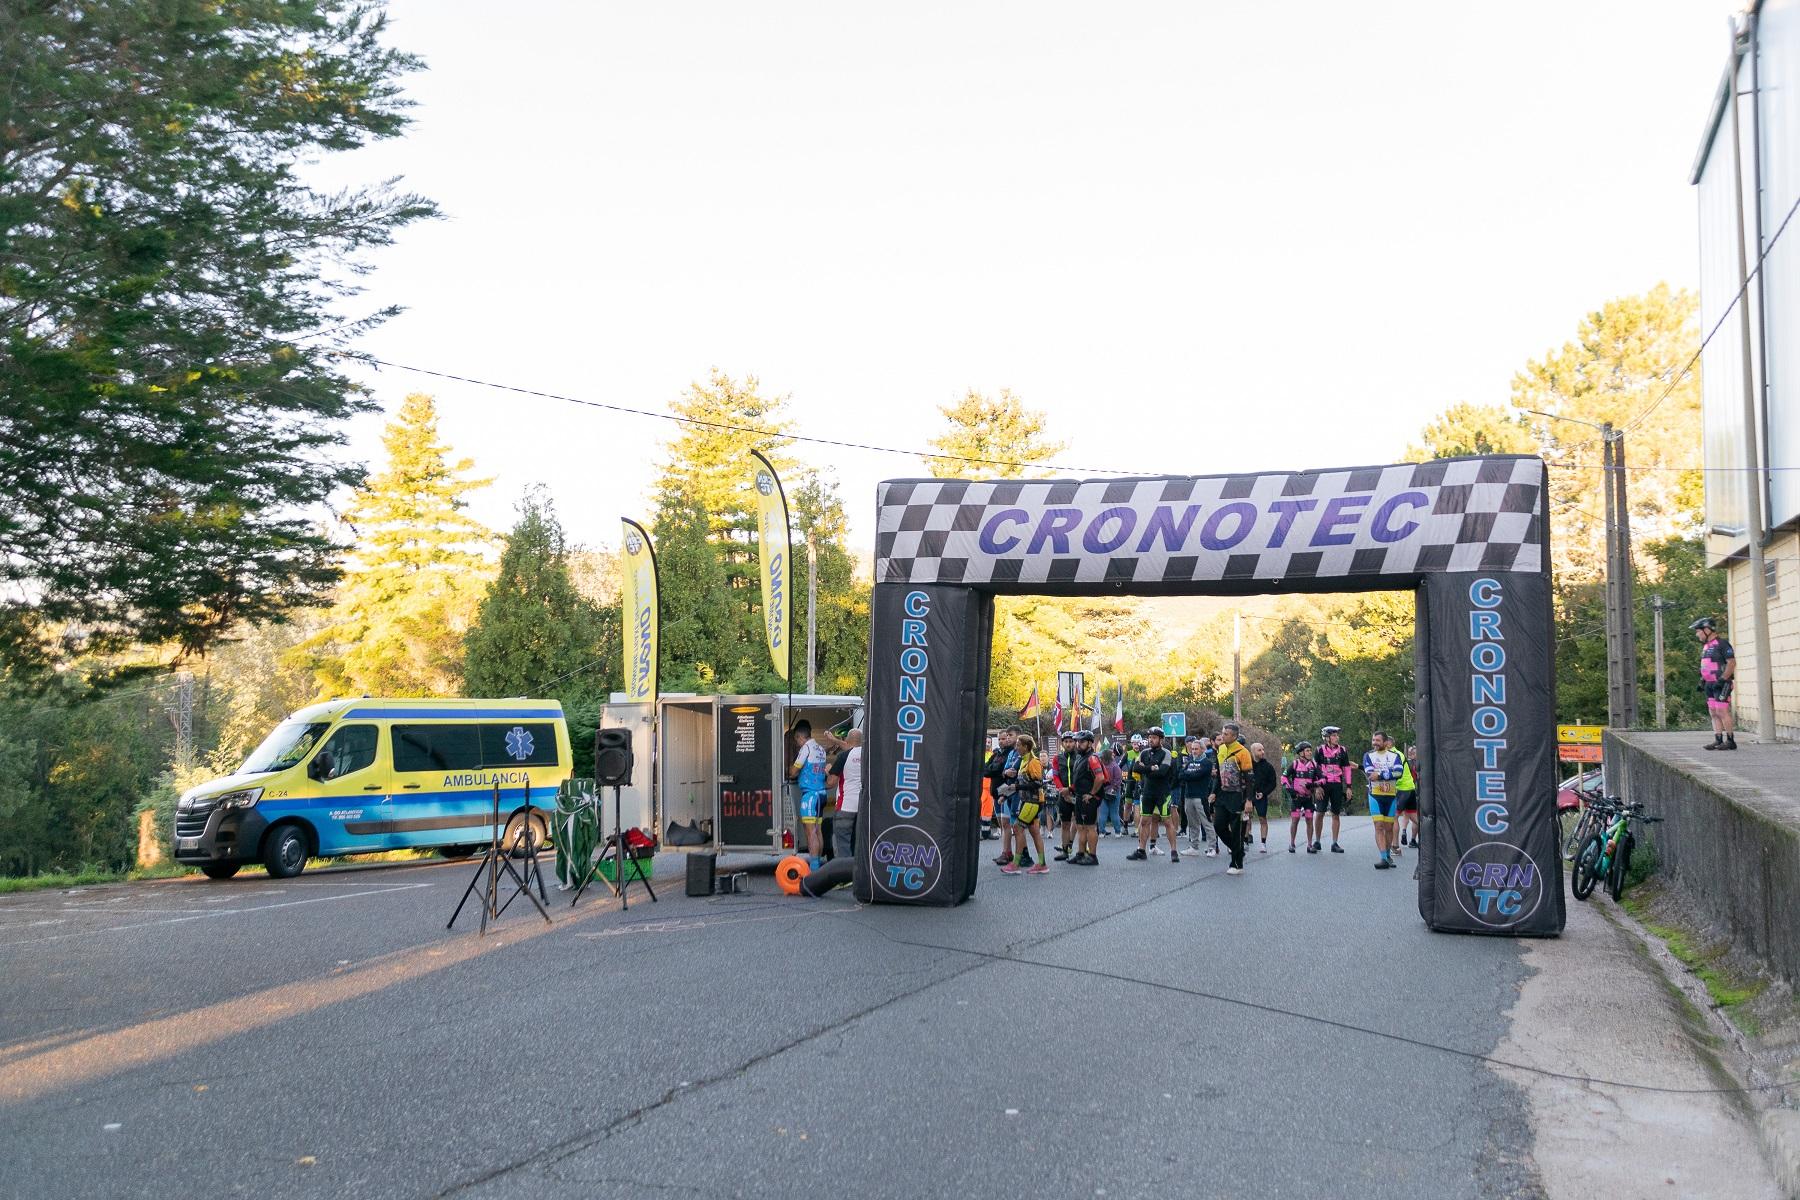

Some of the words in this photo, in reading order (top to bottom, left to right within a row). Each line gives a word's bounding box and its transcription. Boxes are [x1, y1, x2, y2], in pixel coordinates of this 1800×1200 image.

[978, 491, 1429, 554] CRONOTEC
[893, 591, 930, 818] CRONOTEC
[1469, 578, 1509, 835] CRONOTEC
[1168, 715, 1178, 727] C
[443, 771, 530, 787] AMBULANCIA
[268, 790, 288, 798] C-24
[875, 841, 937, 868] CRN
[886, 865, 925, 889] TC
[1459, 861, 1534, 888] CRN
[1474, 889, 1522, 916] TC
